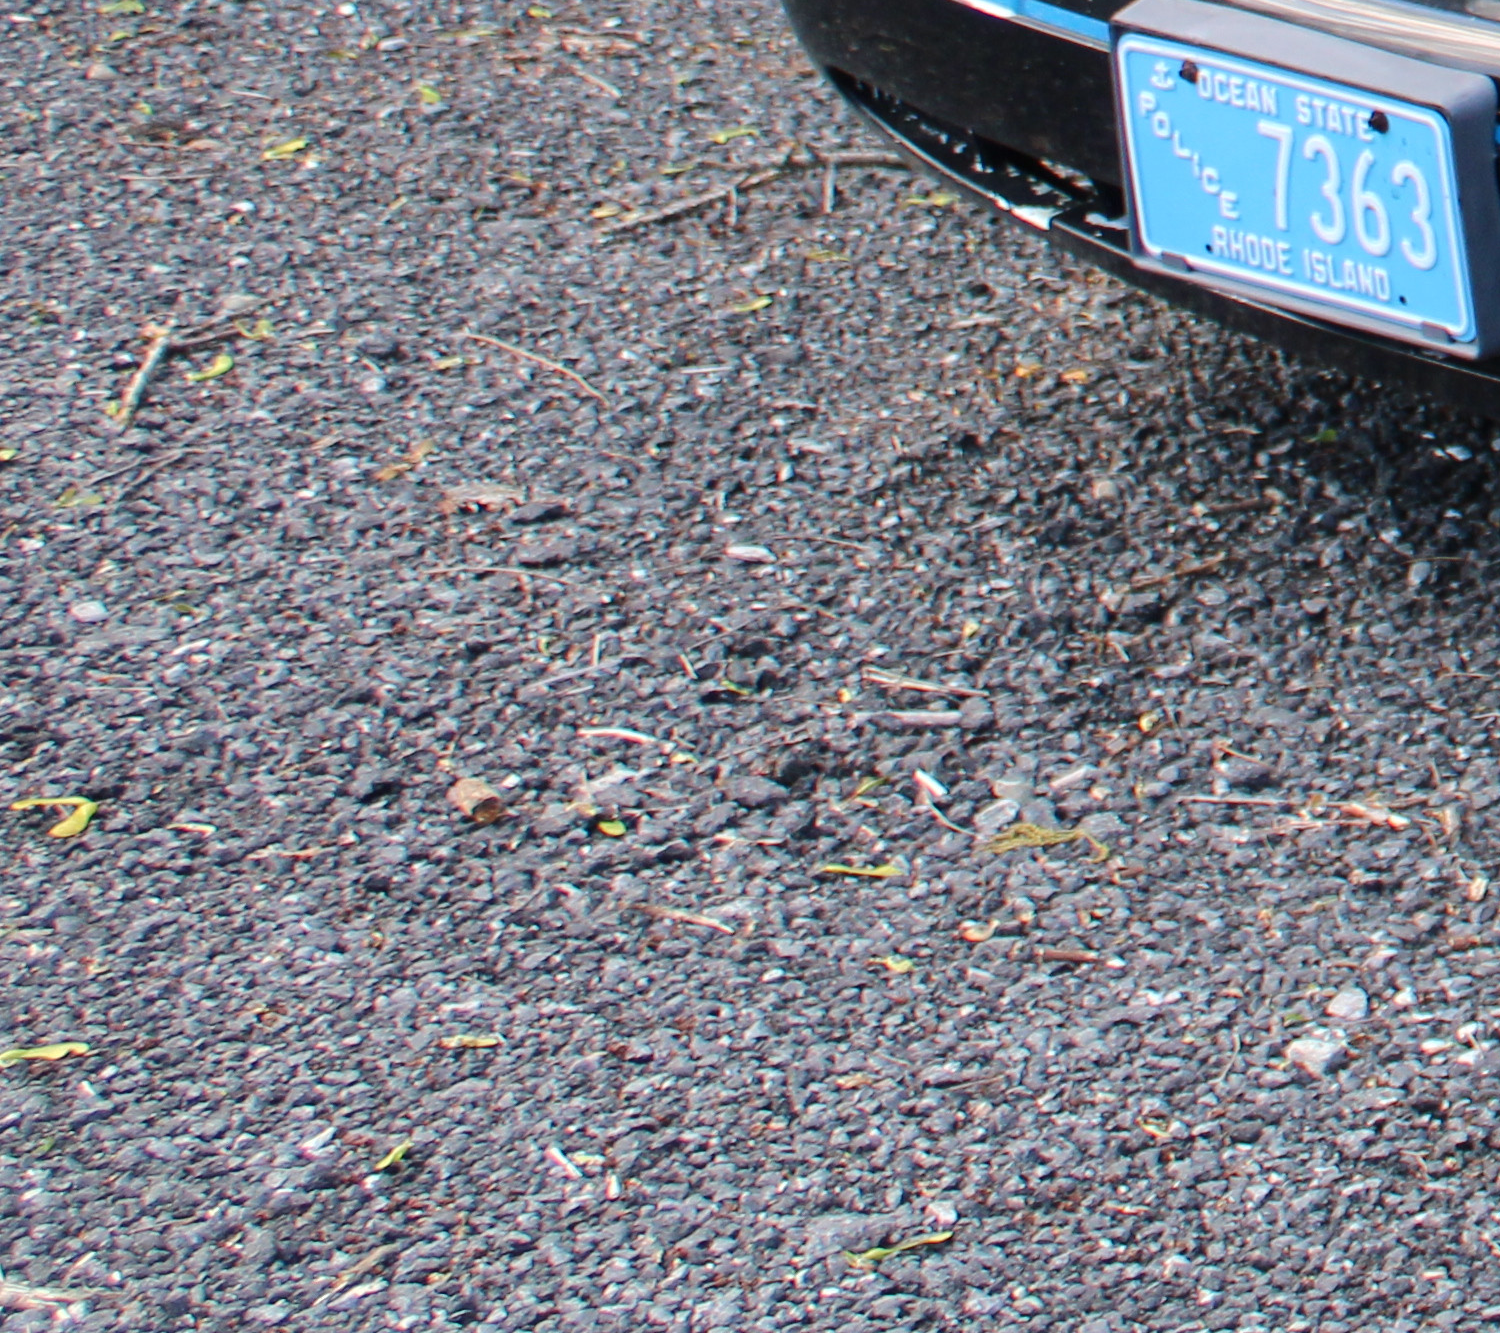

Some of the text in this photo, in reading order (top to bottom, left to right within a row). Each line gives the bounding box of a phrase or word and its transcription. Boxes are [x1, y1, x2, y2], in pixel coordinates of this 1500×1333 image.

[1138, 90, 1239, 220] POLICE
[1197, 68, 1374, 142] OCEAN STATE
[1256, 119, 1437, 271] 7363
[1211, 225, 1391, 302] RHODE ISLAND
